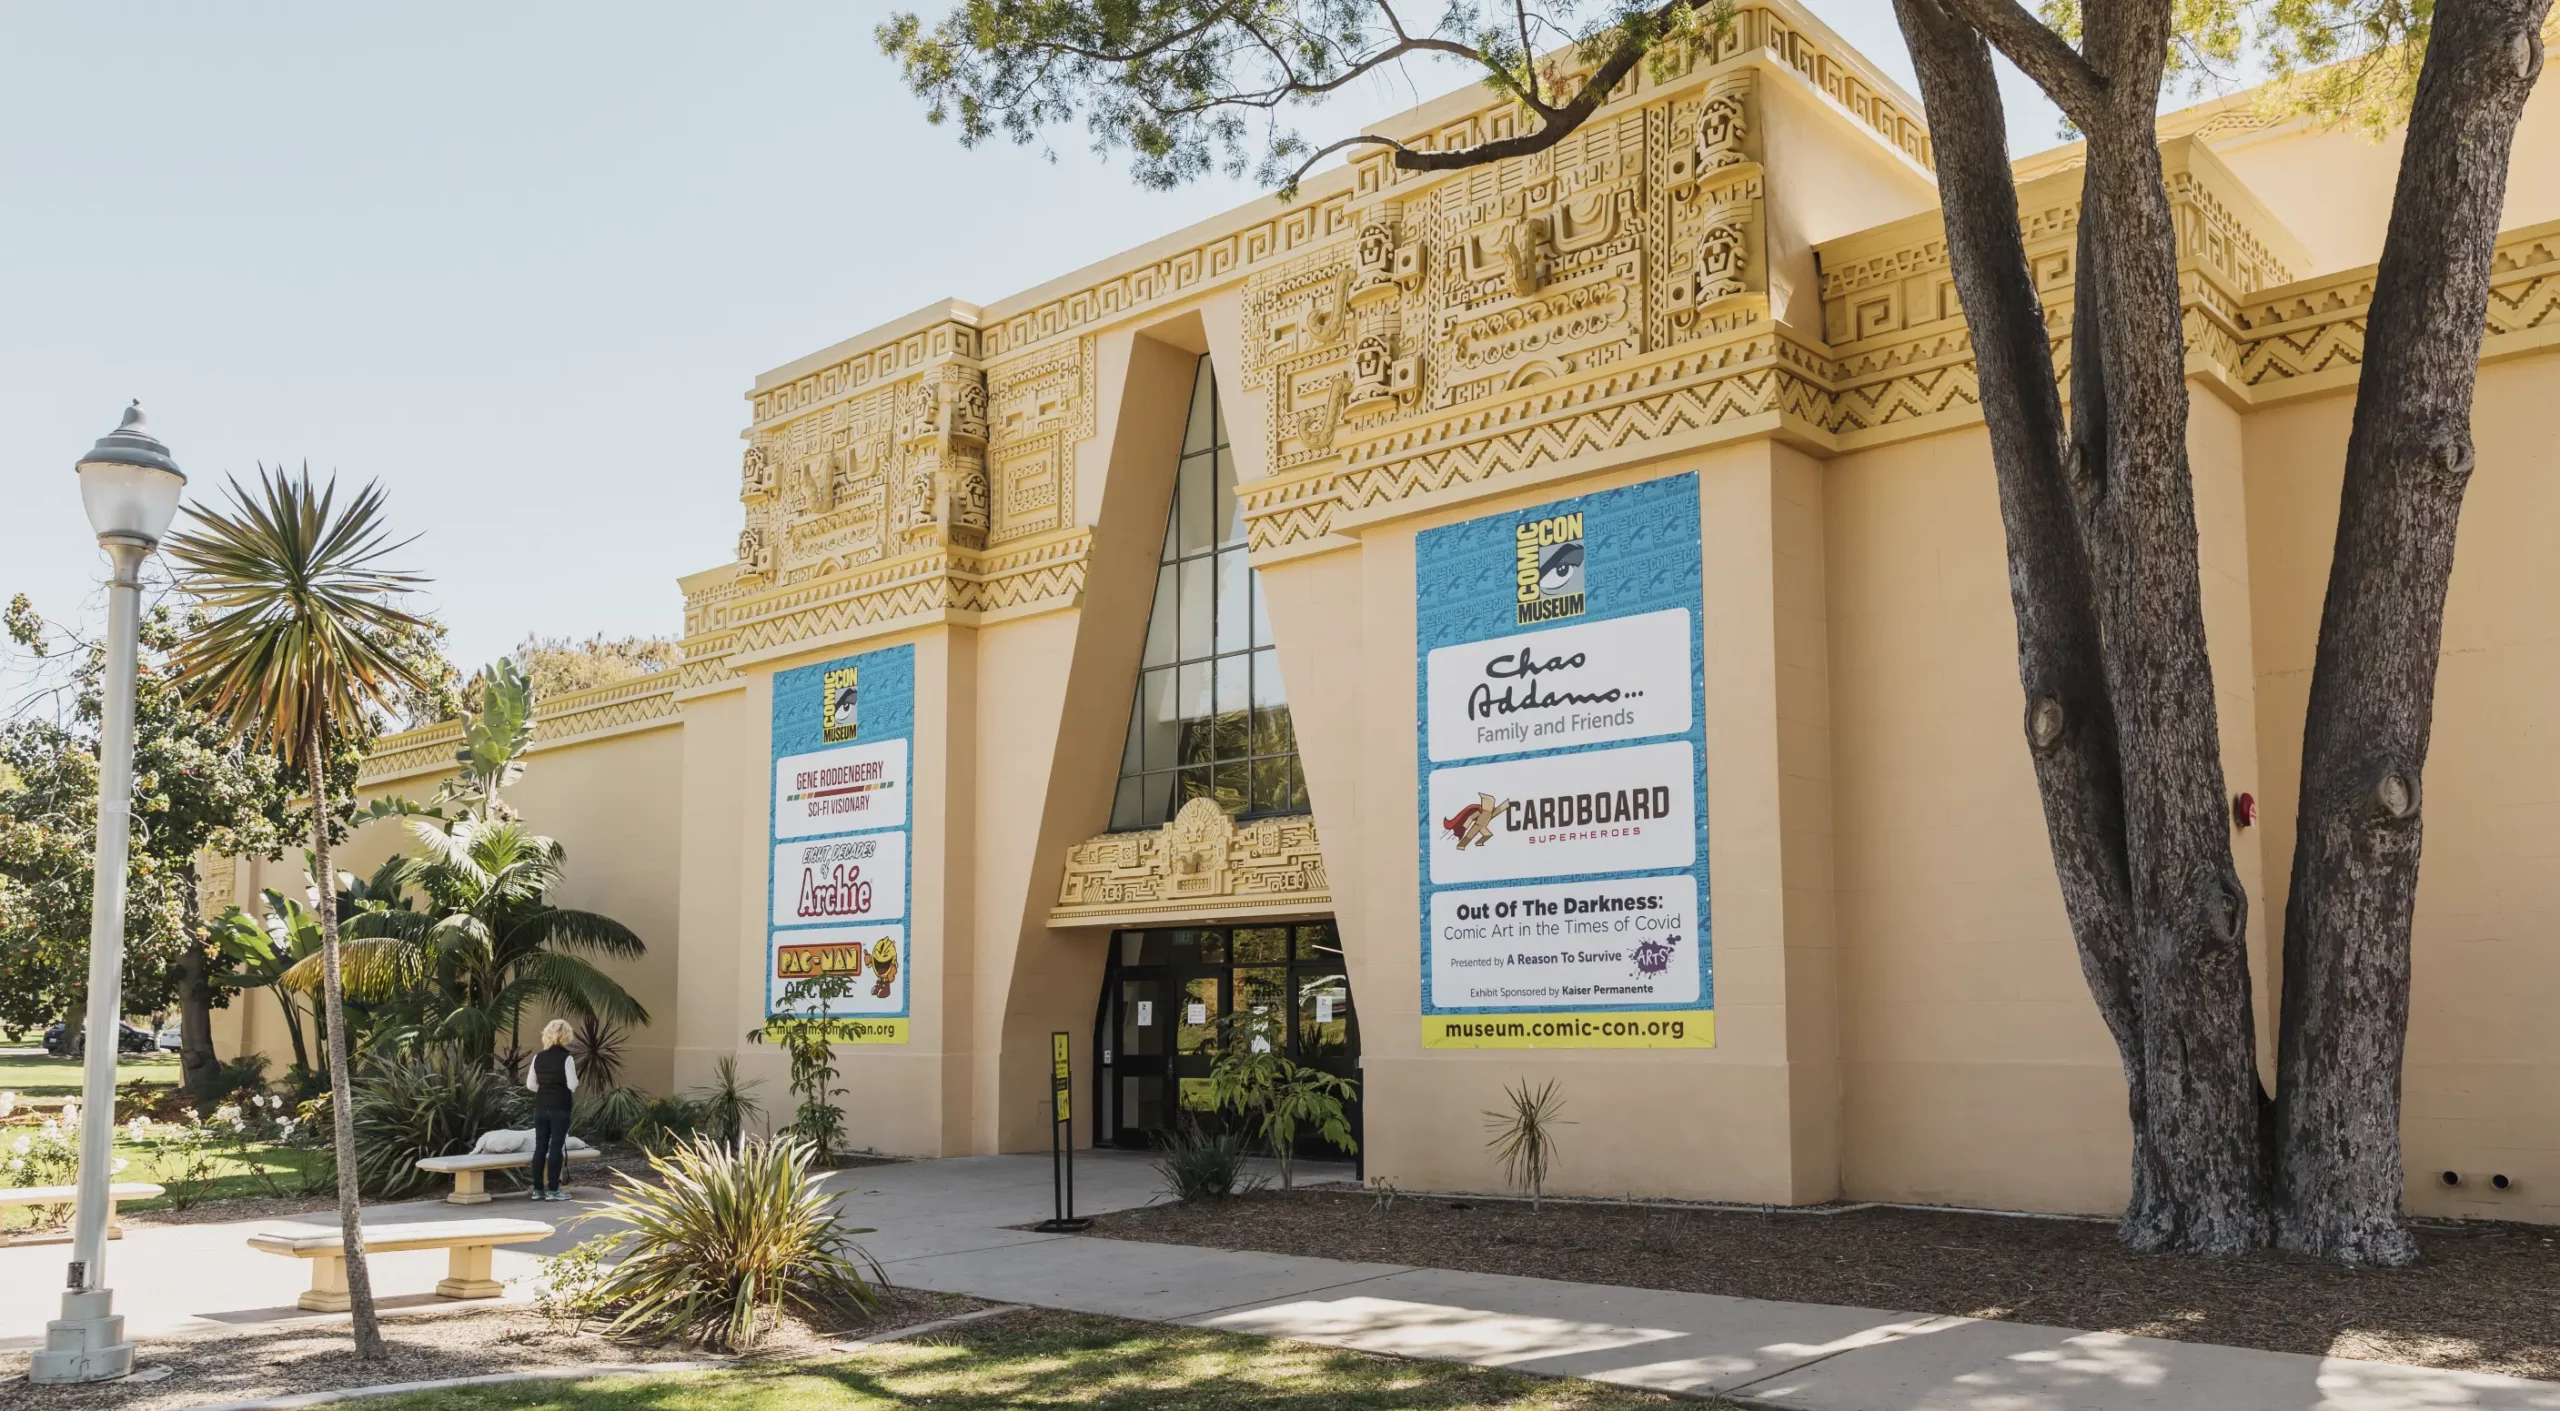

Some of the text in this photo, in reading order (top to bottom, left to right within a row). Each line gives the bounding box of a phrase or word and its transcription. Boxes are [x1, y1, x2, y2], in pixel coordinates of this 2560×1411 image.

[1517, 522, 1540, 602] COMIC
[1539, 512, 1583, 547] CON
[1518, 594, 1584, 624] MUSEUM
[824, 667, 857, 728] COMIC CON
[823, 724, 857, 743] MUSEUM
[1477, 708, 1635, 743] Family and Friends
[796, 761, 884, 790] GENE RODDENBERRY
[808, 795, 870, 817] SCI-FI VISIONARY
[1506, 785, 1670, 832] CARDBOARD
[1529, 827, 1641, 844] SUPERHEROES
[802, 840, 876, 864] EIGHT DECADES
[820, 860, 830, 880] of
[797, 864, 872, 917] Archie
[1456, 895, 1663, 921] Out Of The Darkness:
[1444, 913, 1681, 940] Comic Art in the Times of Covid
[780, 948, 859, 973] PAC-MAN
[1450, 950, 1622, 968] Presented by A Reason To Survive
[1637, 948, 1667, 966] ARTS
[1470, 984, 1654, 999] Exhibit Sponsored by Kaiser Permanente
[1446, 1018, 1685, 1039] museum.comic-con.org
